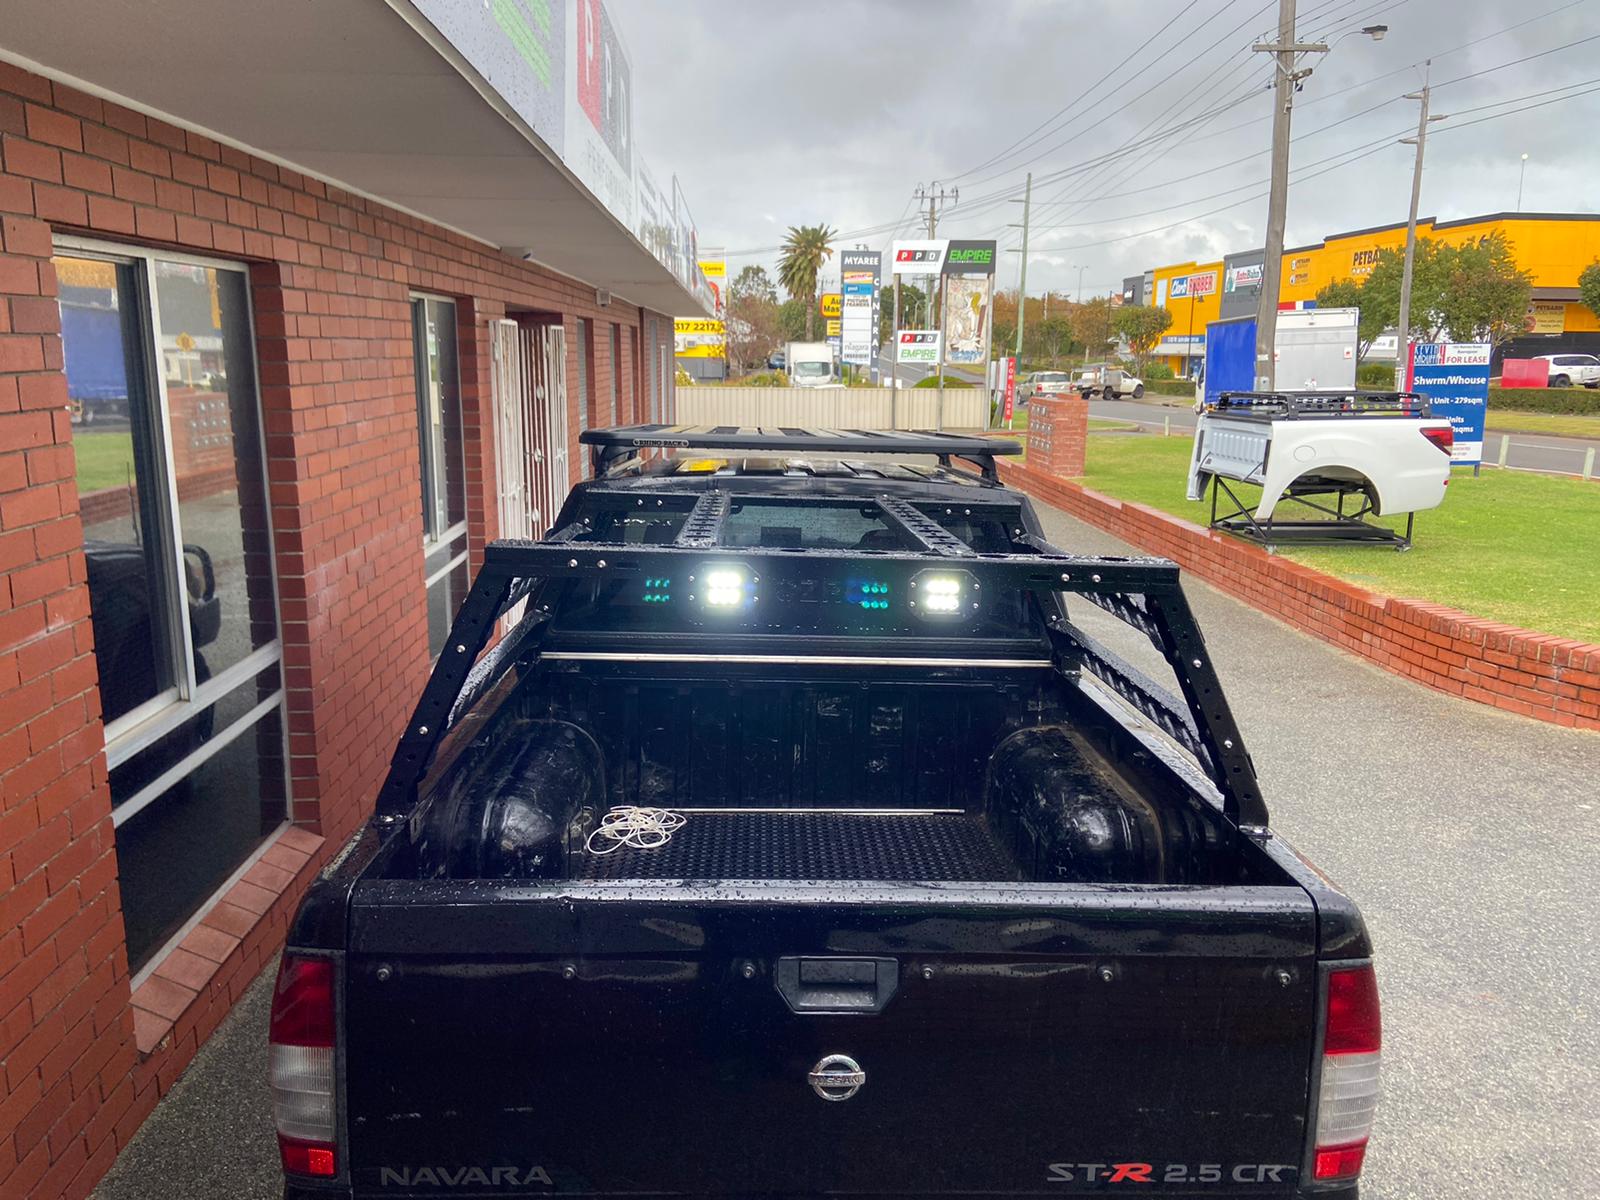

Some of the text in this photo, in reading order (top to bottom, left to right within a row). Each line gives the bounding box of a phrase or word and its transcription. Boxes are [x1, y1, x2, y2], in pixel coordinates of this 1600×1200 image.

[901, 251, 936, 261] PPD
[949, 249, 993, 261] EMPIRE
[844, 256, 880, 266] MYAREE
[1171, 278, 1187, 297] Clark
[1188, 274, 1215, 293] RUBBER
[871, 278, 880, 359] CENTRAL
[904, 334, 934, 342] PPD
[901, 348, 937, 359] EMPIRE
[1447, 356, 1462, 364] FOR
[1463, 355, 1488, 364] LEASE
[1413, 375, 1487, 386] Shwrm/Whouse
[1005, 383, 1013, 416] LEASE
[1434, 396, 1450, 405] Unit
[1454, 396, 1484, 405] 279sqm
[380, 1166, 553, 1186] NAVARA
[1047, 1162, 1298, 1183] ST-R 2.5 CR
